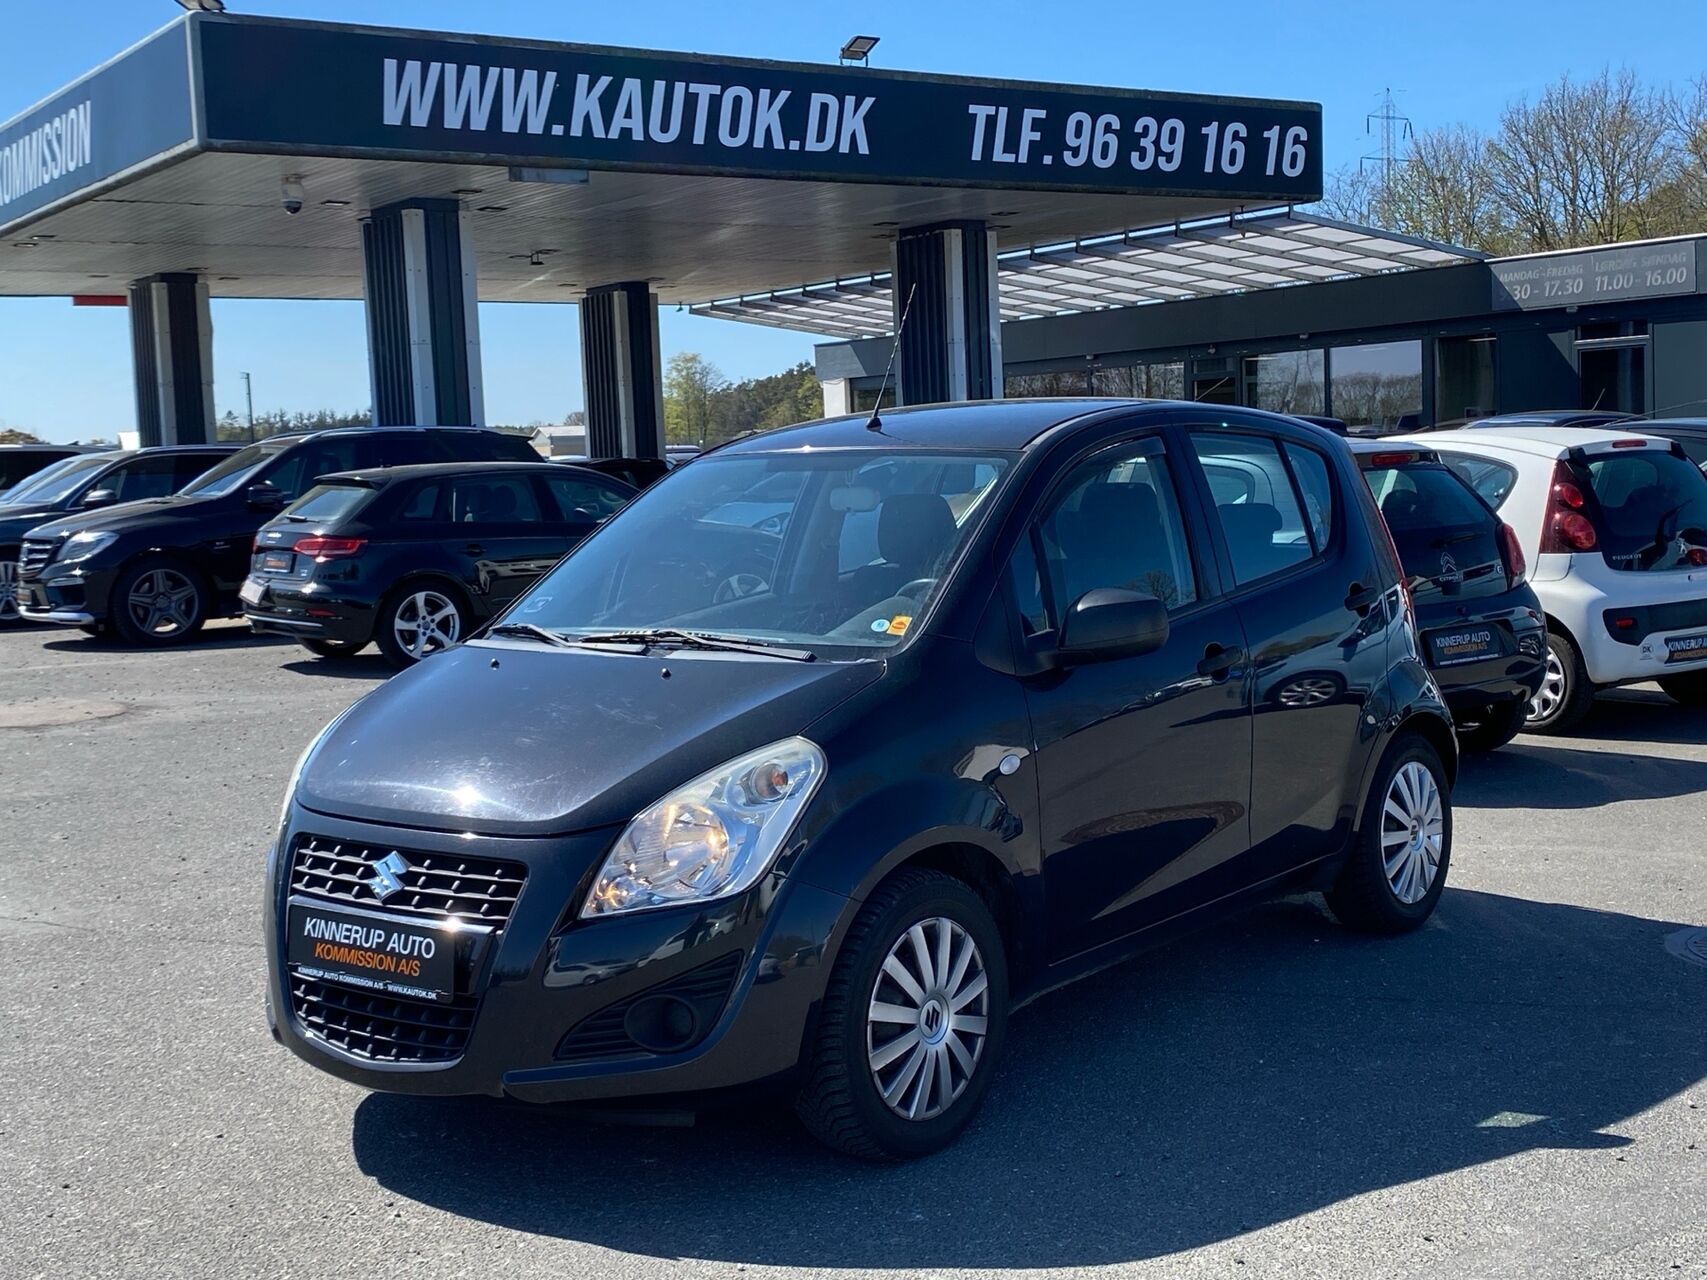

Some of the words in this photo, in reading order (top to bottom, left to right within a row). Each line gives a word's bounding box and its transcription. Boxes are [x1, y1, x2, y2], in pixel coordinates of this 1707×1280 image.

[383, 58, 876, 155] WWW.KAUTOK.DK
[968, 104, 1053, 165] TLF.
[1063, 111, 1120, 169] 96
[1130, 116, 1185, 172] 39
[1201, 121, 1248, 174] 16
[1263, 125, 1308, 178] 16
[1544, 277, 1583, 297] 17.30
[1595, 274, 1633, 292] 11.00
[1645, 267, 1687, 286] 16.00
[1435, 634, 1470, 648] KINNERUP
[1471, 631, 1491, 643] AUTO
[304, 917, 385, 949] KINNERUP
[387, 932, 436, 959] AUTO
[298, 967, 323, 977] KINNERUP
[323, 971, 339, 981] AUTO
[315, 943, 397, 973] KOMMISSION
[398, 959, 421, 977] A/S
